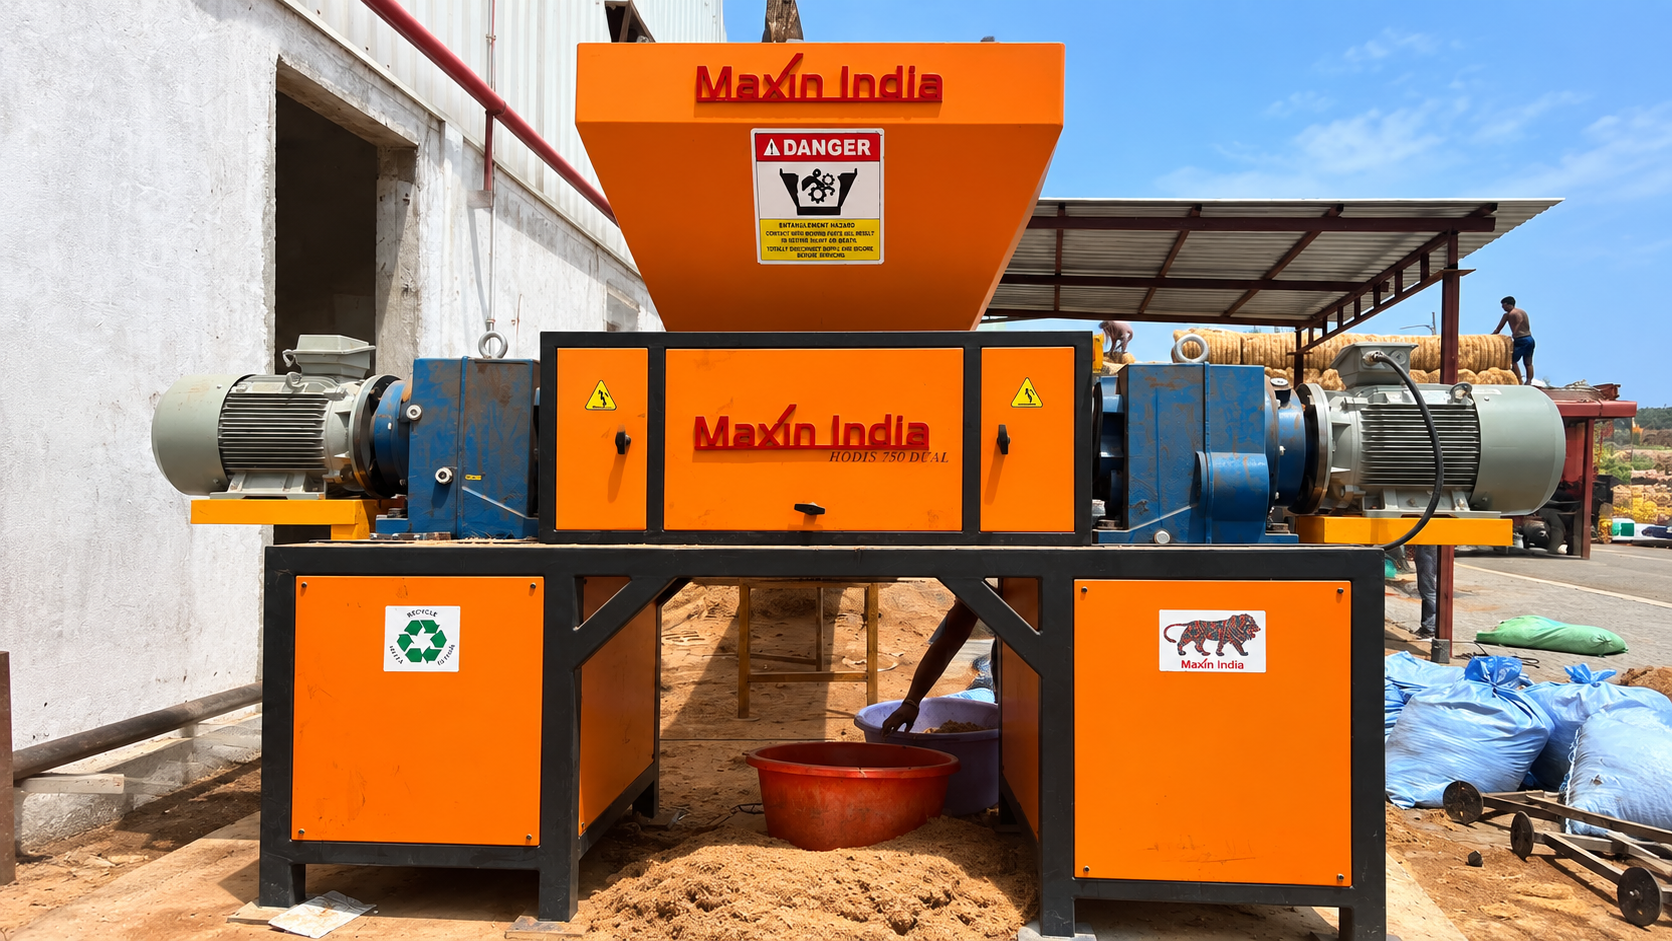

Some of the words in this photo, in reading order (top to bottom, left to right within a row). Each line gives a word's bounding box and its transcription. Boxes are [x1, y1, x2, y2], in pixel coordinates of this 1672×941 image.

[696, 53, 824, 99] Maxin
[841, 65, 943, 99] India
[783, 139, 871, 156] DANGER
[694, 404, 816, 447] Maxin
[832, 413, 930, 447] India
[829, 451, 877, 463] HODIS
[881, 451, 905, 463] 750
[909, 451, 950, 463] DUAL
[1181, 658, 1214, 669] Maxin
[1217, 660, 1244, 670] India
